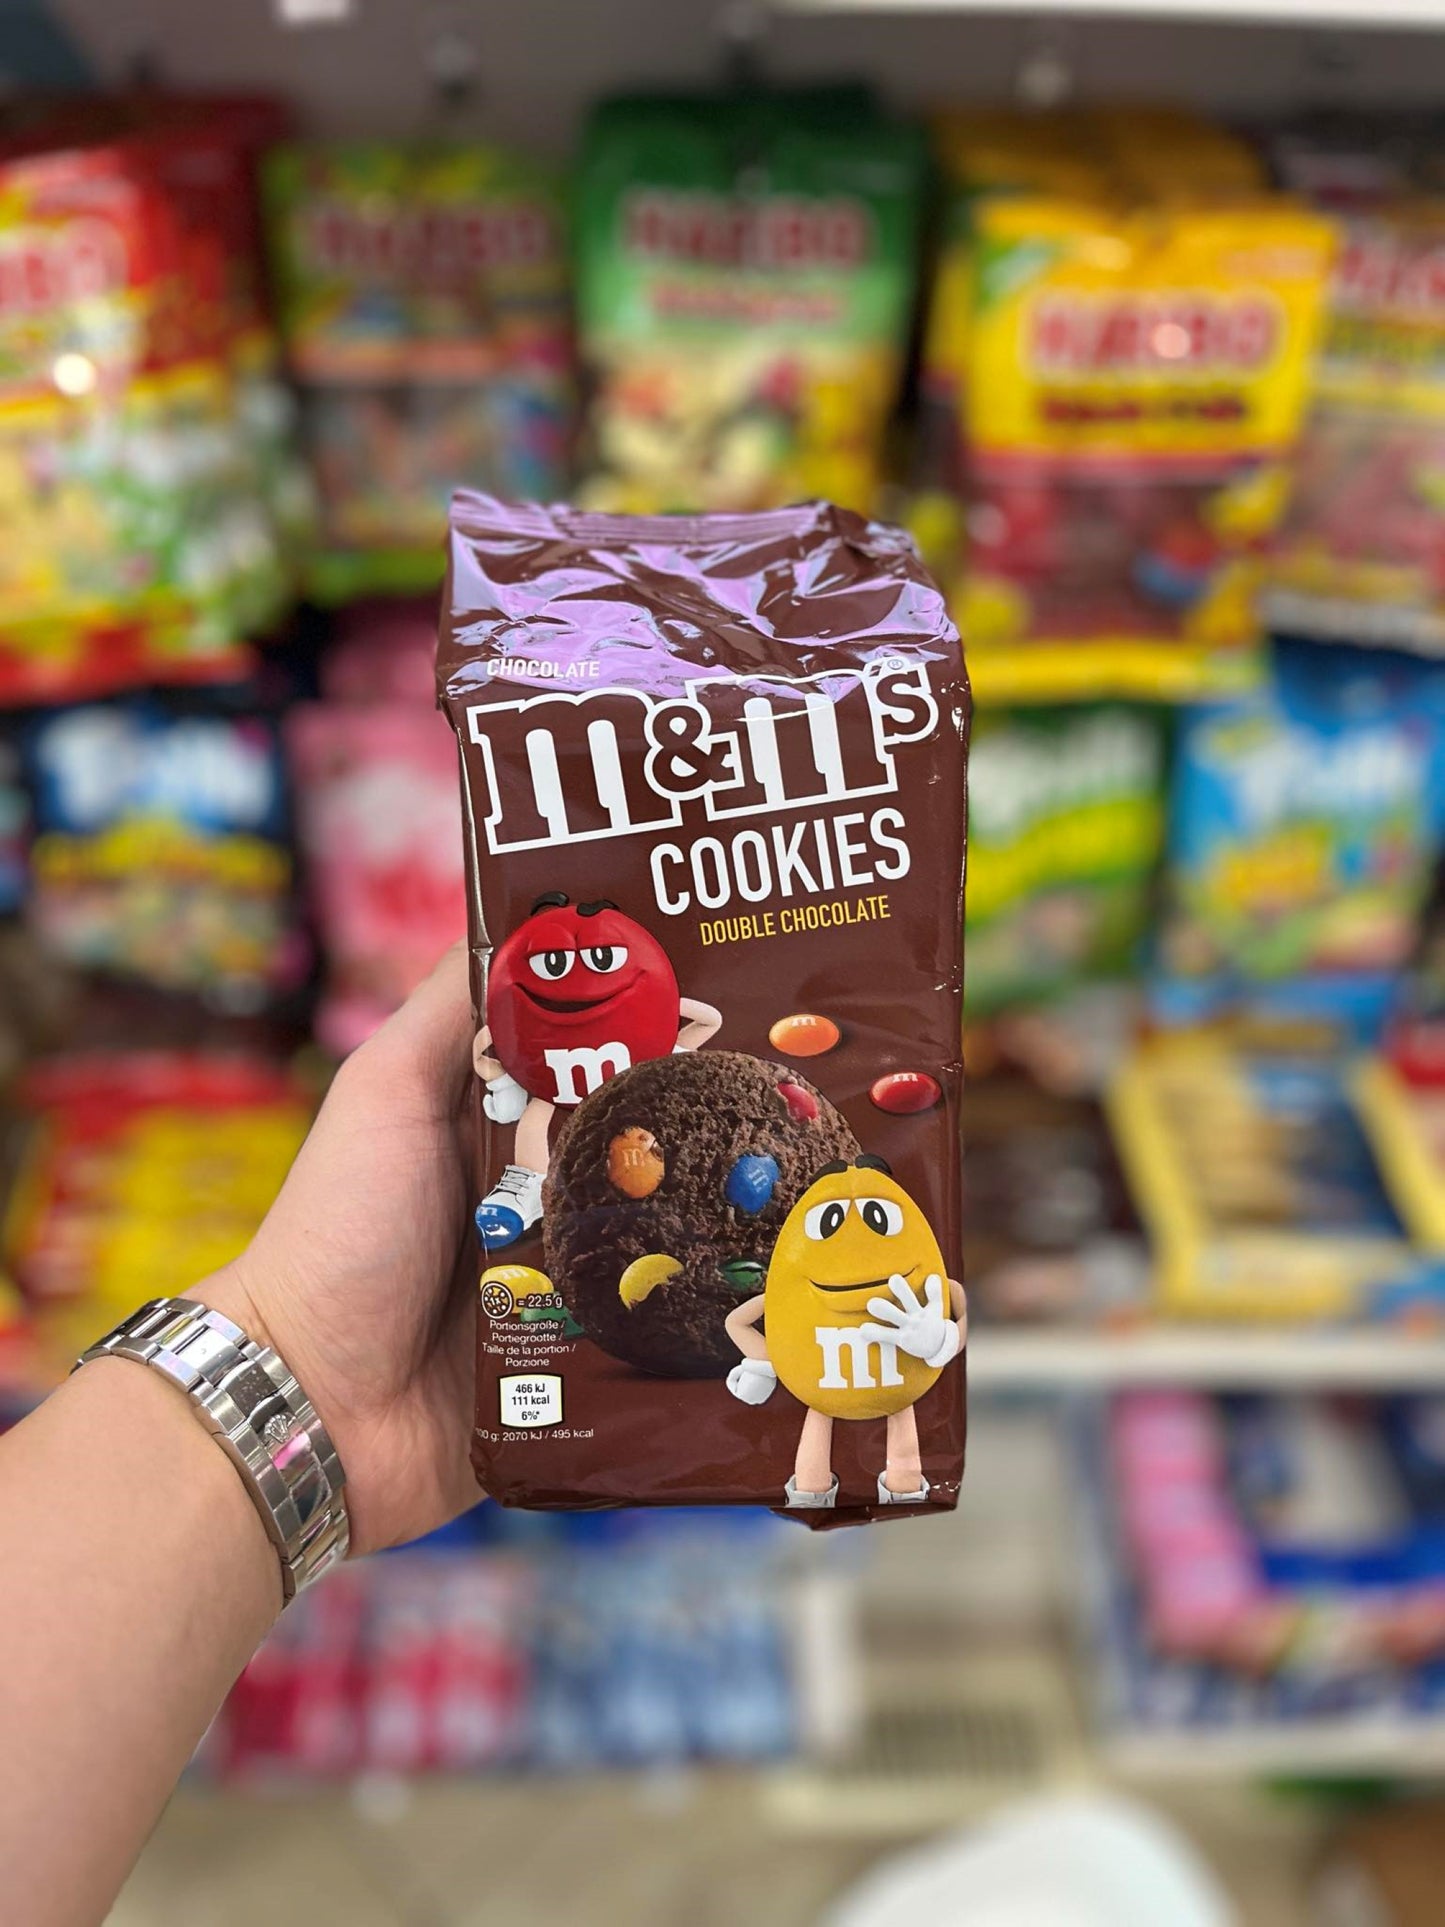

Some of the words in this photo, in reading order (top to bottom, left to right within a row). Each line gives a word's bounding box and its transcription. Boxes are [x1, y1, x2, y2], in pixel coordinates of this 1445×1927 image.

[486, 658, 601, 678] CHOCOLATE
[650, 807, 911, 916] COOKIES
[700, 912, 777, 946] DOUBLE
[780, 895, 892, 934] CHOCOLATE
[527, 1294, 553, 1308] 22.5
[555, 1295, 563, 1309] g
[492, 1332, 557, 1345] Portiegrootte
[507, 1345, 520, 1355] de
[522, 1345, 531, 1355] la
[533, 1344, 570, 1356] portion
[505, 1357, 550, 1367] Porzione
[815, 1325, 905, 1390] m
[515, 1383, 533, 1394] 466
[535, 1383, 546, 1393] kJ
[511, 1396, 529, 1406] 111
[531, 1395, 550, 1406] kcal
[502, 1431, 528, 1441] 2070
[530, 1430, 543, 1440] kJ
[551, 1429, 571, 1440] 495
[573, 1428, 594, 1439] kcal
